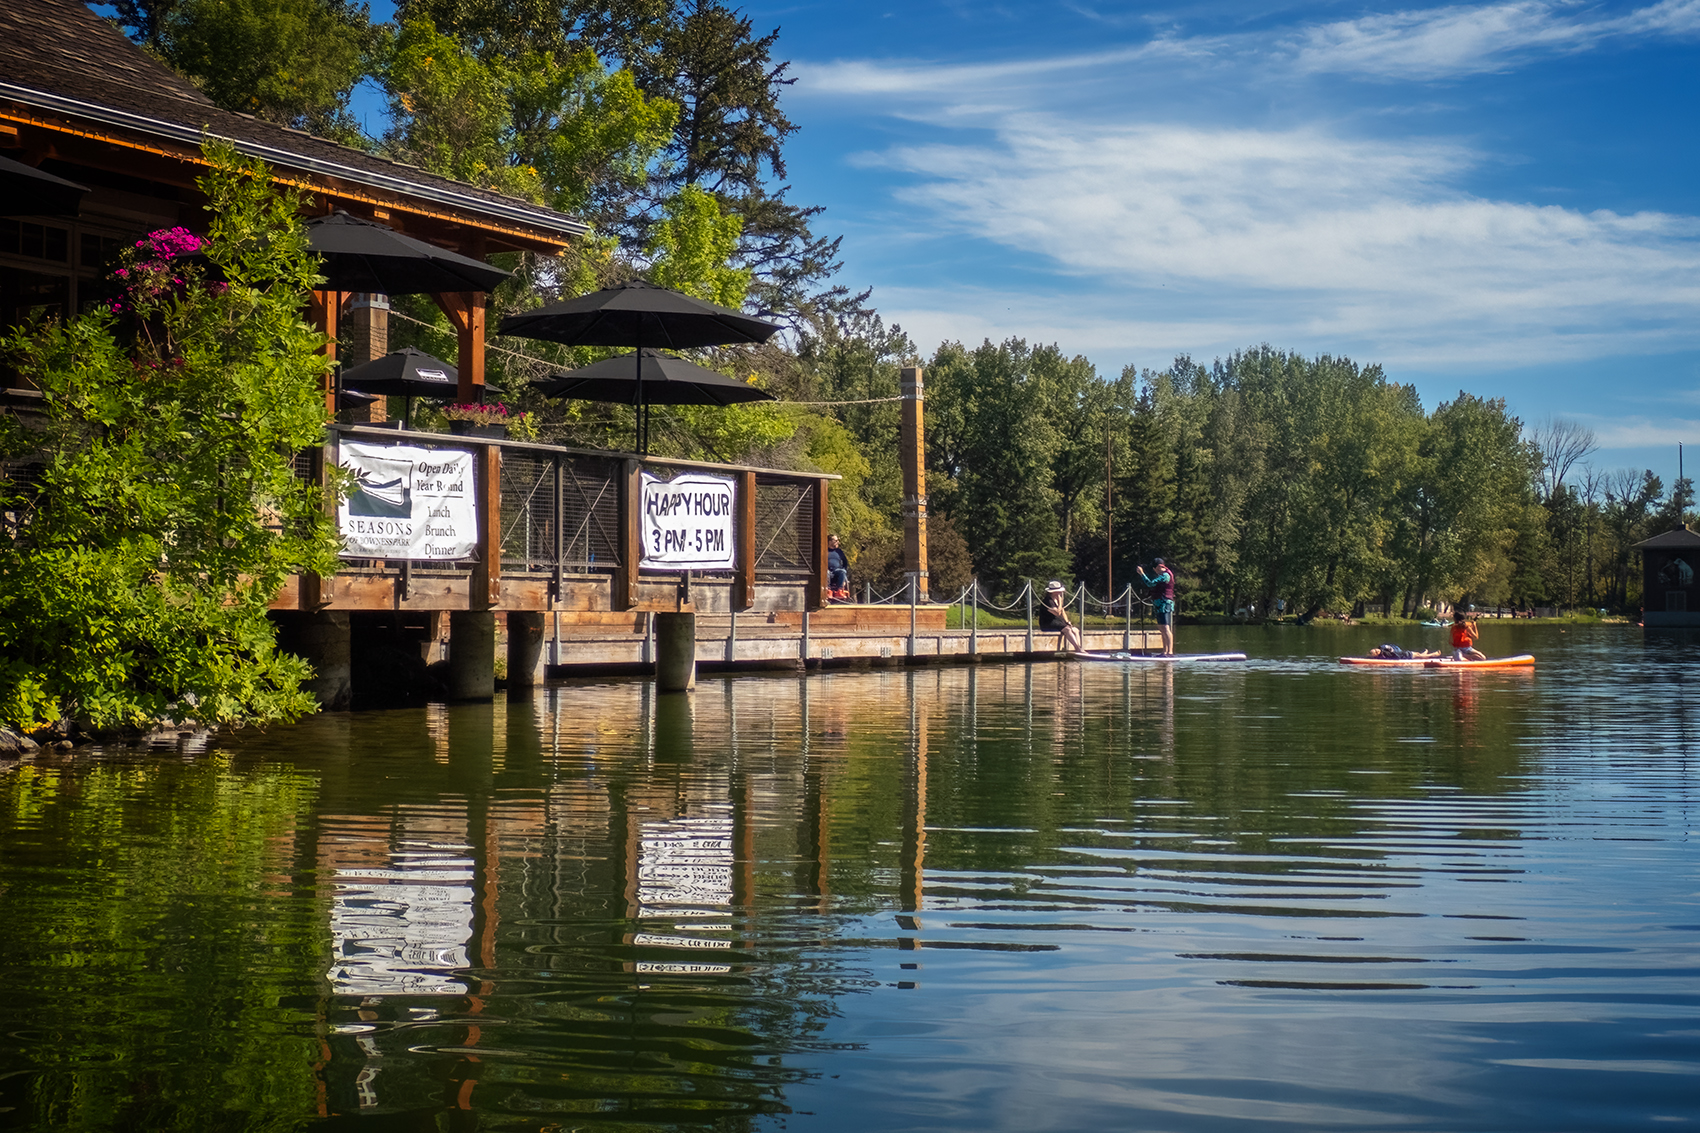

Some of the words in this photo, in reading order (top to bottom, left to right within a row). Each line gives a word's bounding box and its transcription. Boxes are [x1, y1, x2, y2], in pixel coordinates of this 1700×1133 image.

[419, 461, 441, 477] Open
[417, 479, 434, 491] Year
[647, 492, 692, 516] HAPPY
[694, 492, 729, 516] HOUR
[427, 505, 451, 518] Lunch
[348, 519, 413, 536] SEASONS
[425, 524, 457, 537] Brunch
[652, 529, 661, 552] 3
[665, 529, 687, 552] PM
[695, 529, 703, 552] 5
[705, 529, 724, 552] PM
[424, 543, 457, 555] Dinner
